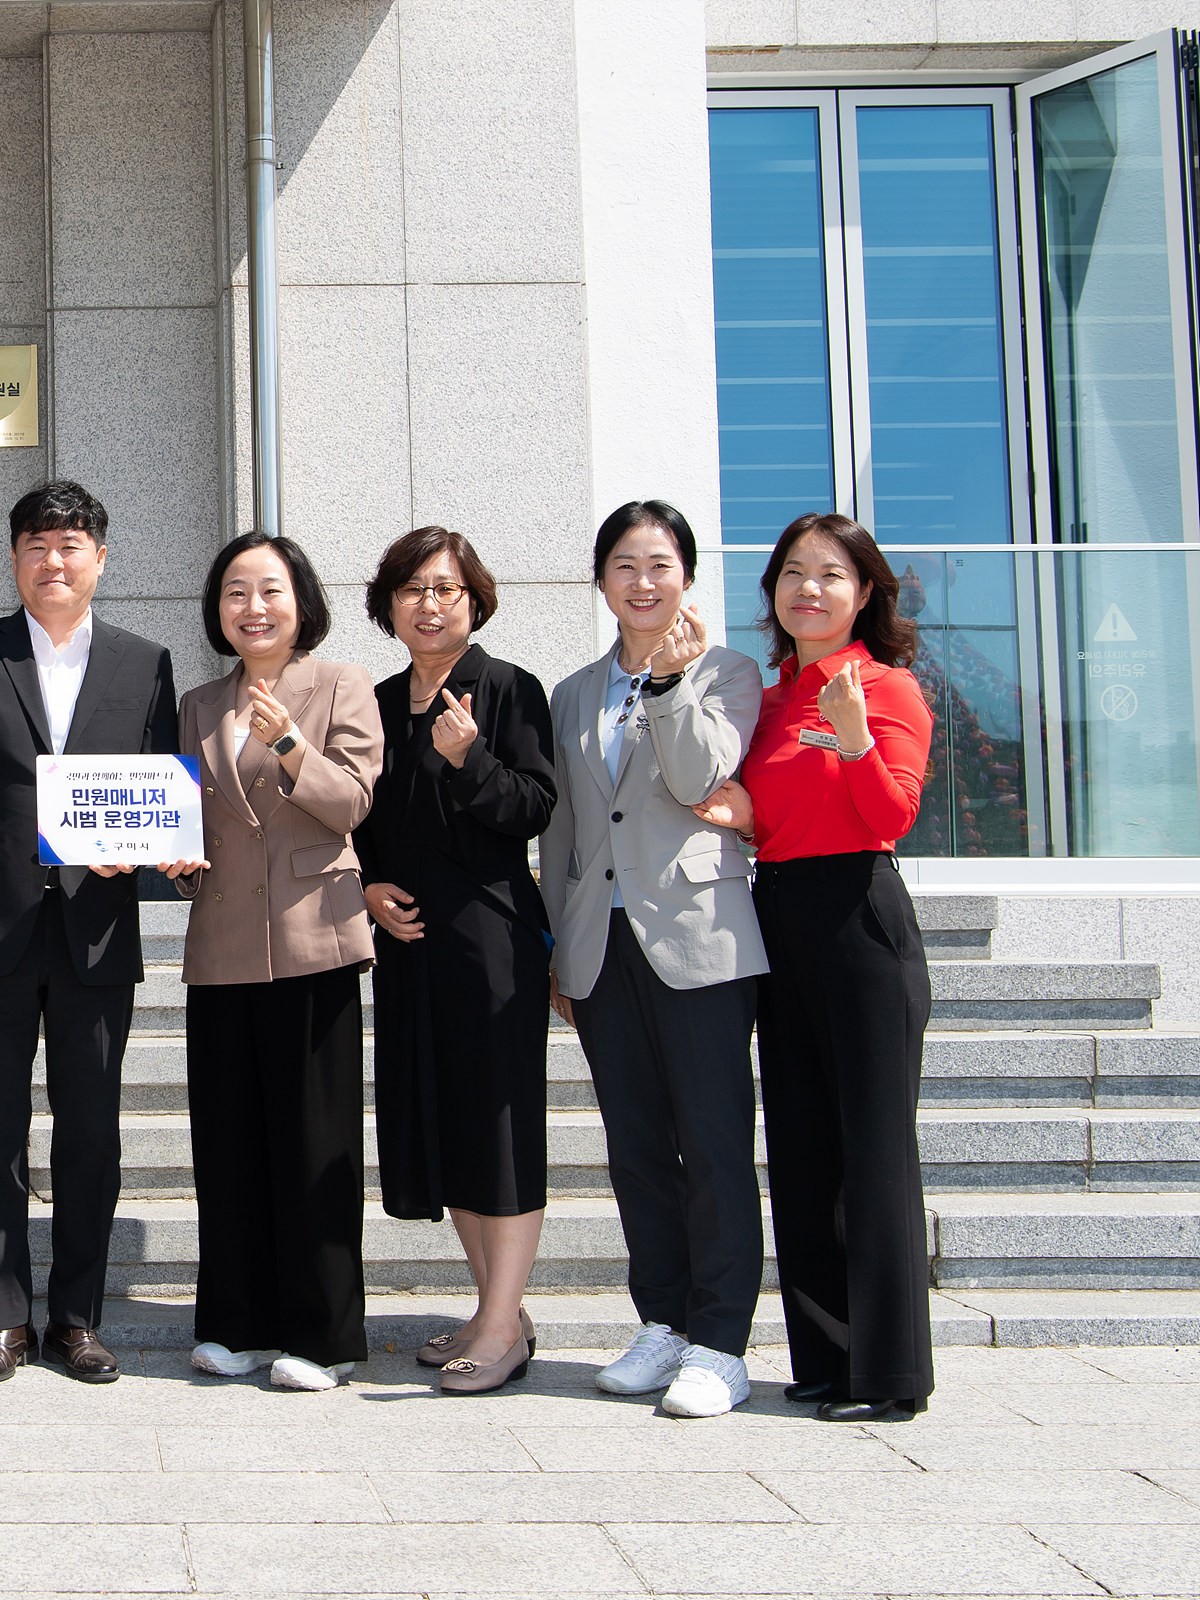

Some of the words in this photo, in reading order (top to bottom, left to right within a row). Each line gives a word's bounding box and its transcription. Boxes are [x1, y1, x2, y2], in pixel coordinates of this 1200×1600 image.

[72, 788, 166, 806] 민원매니저
[60, 811, 97, 828] 시범
[104, 810, 181, 828] 운영기관
[113, 842, 149, 850] 구미시
